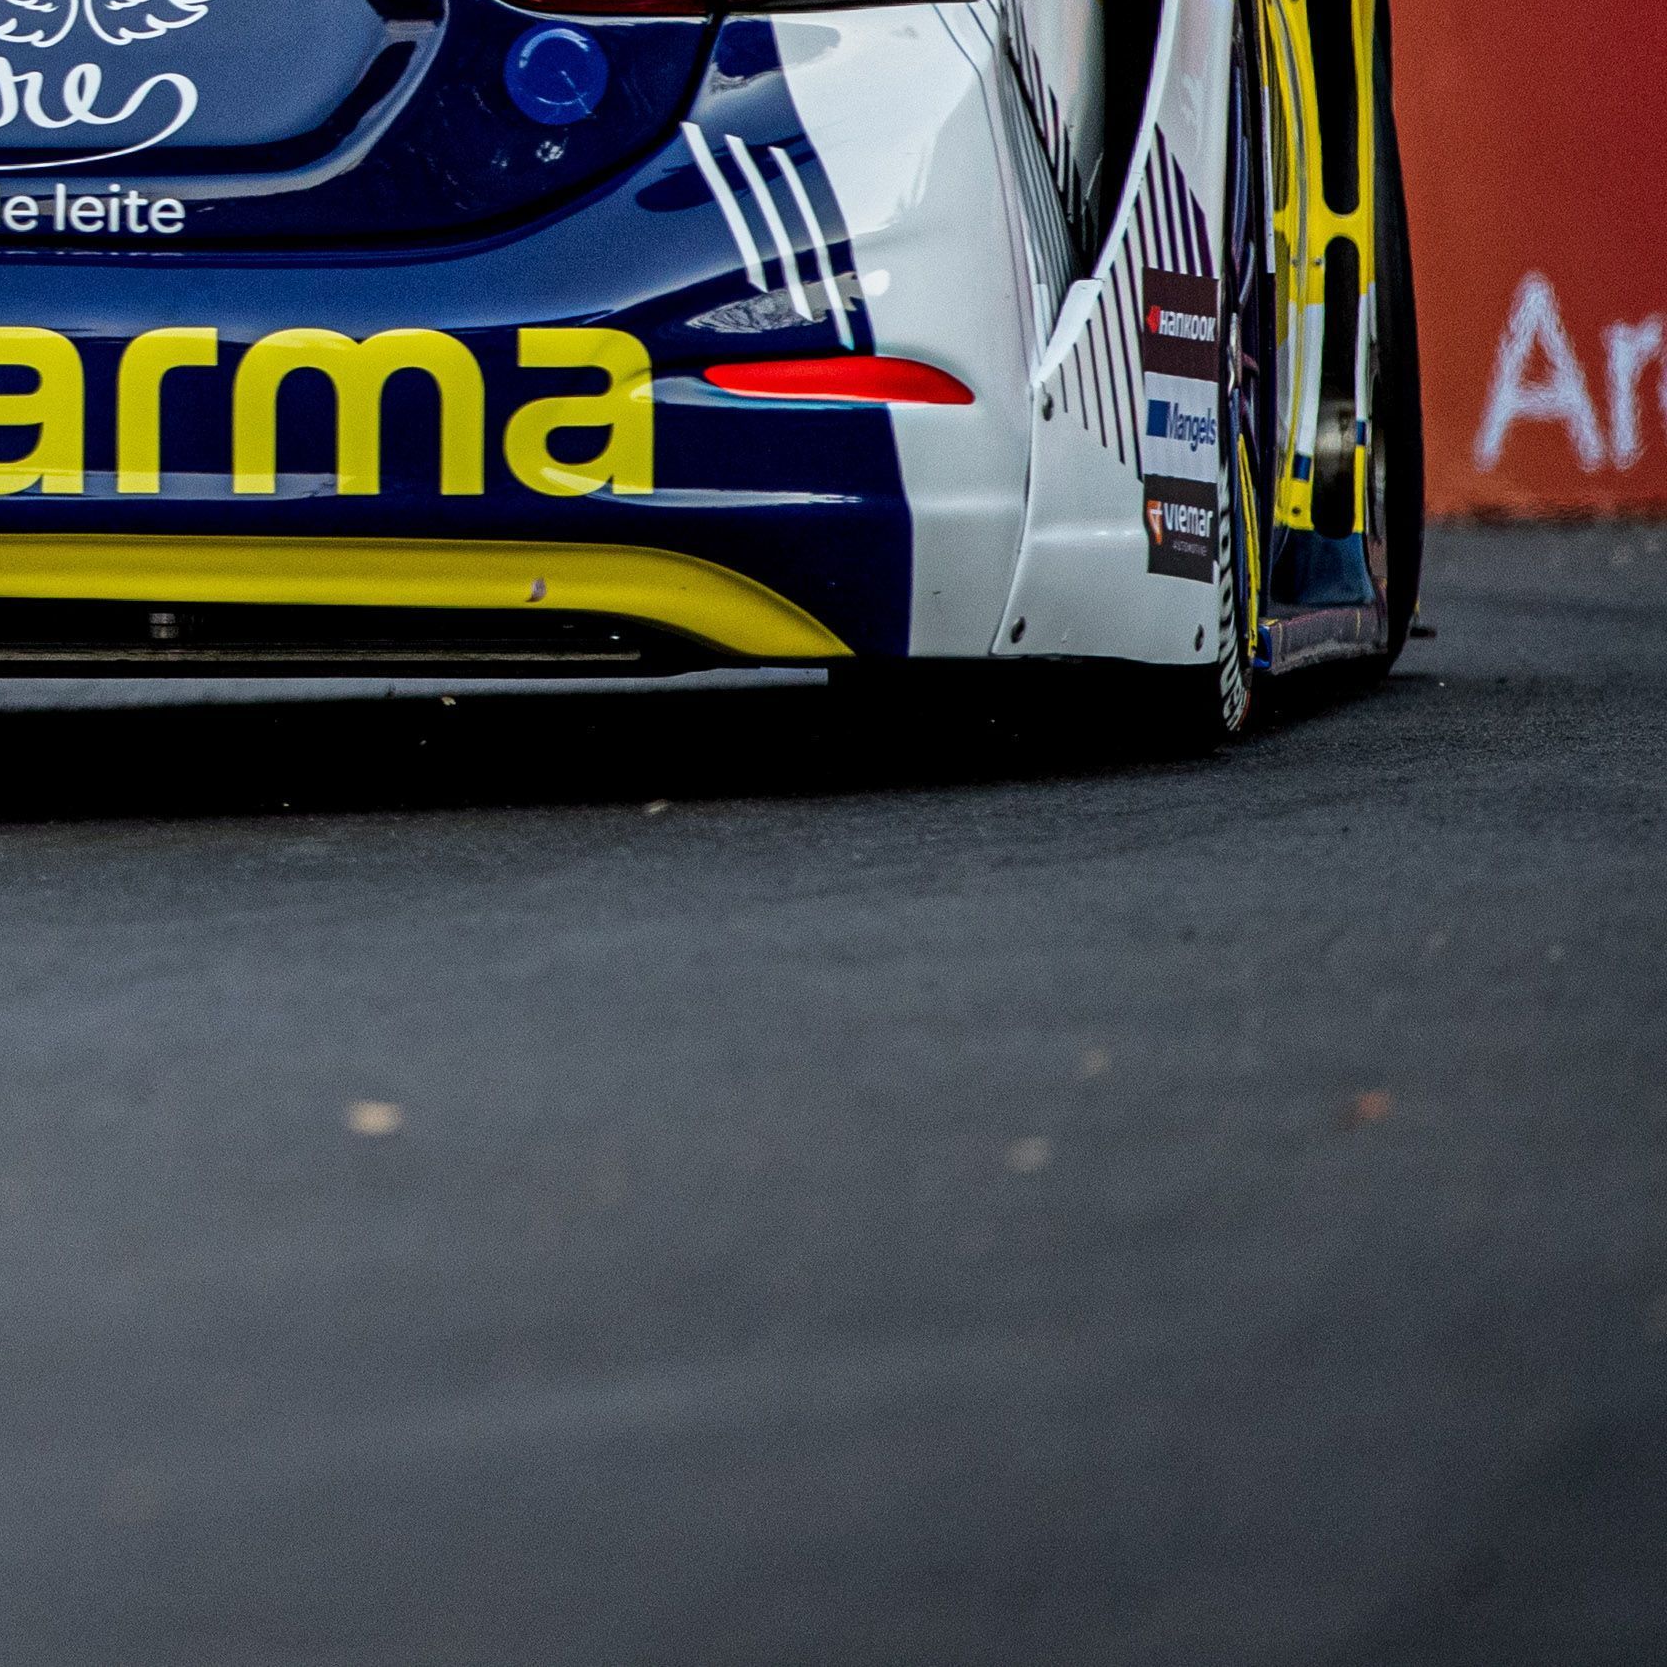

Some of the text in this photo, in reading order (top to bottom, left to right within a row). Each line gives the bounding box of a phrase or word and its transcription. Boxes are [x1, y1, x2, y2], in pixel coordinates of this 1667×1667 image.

[54, 183, 187, 235] leite
[1473, 271, 1667, 473] Ar
[1166, 401, 1217, 453] Mangels
